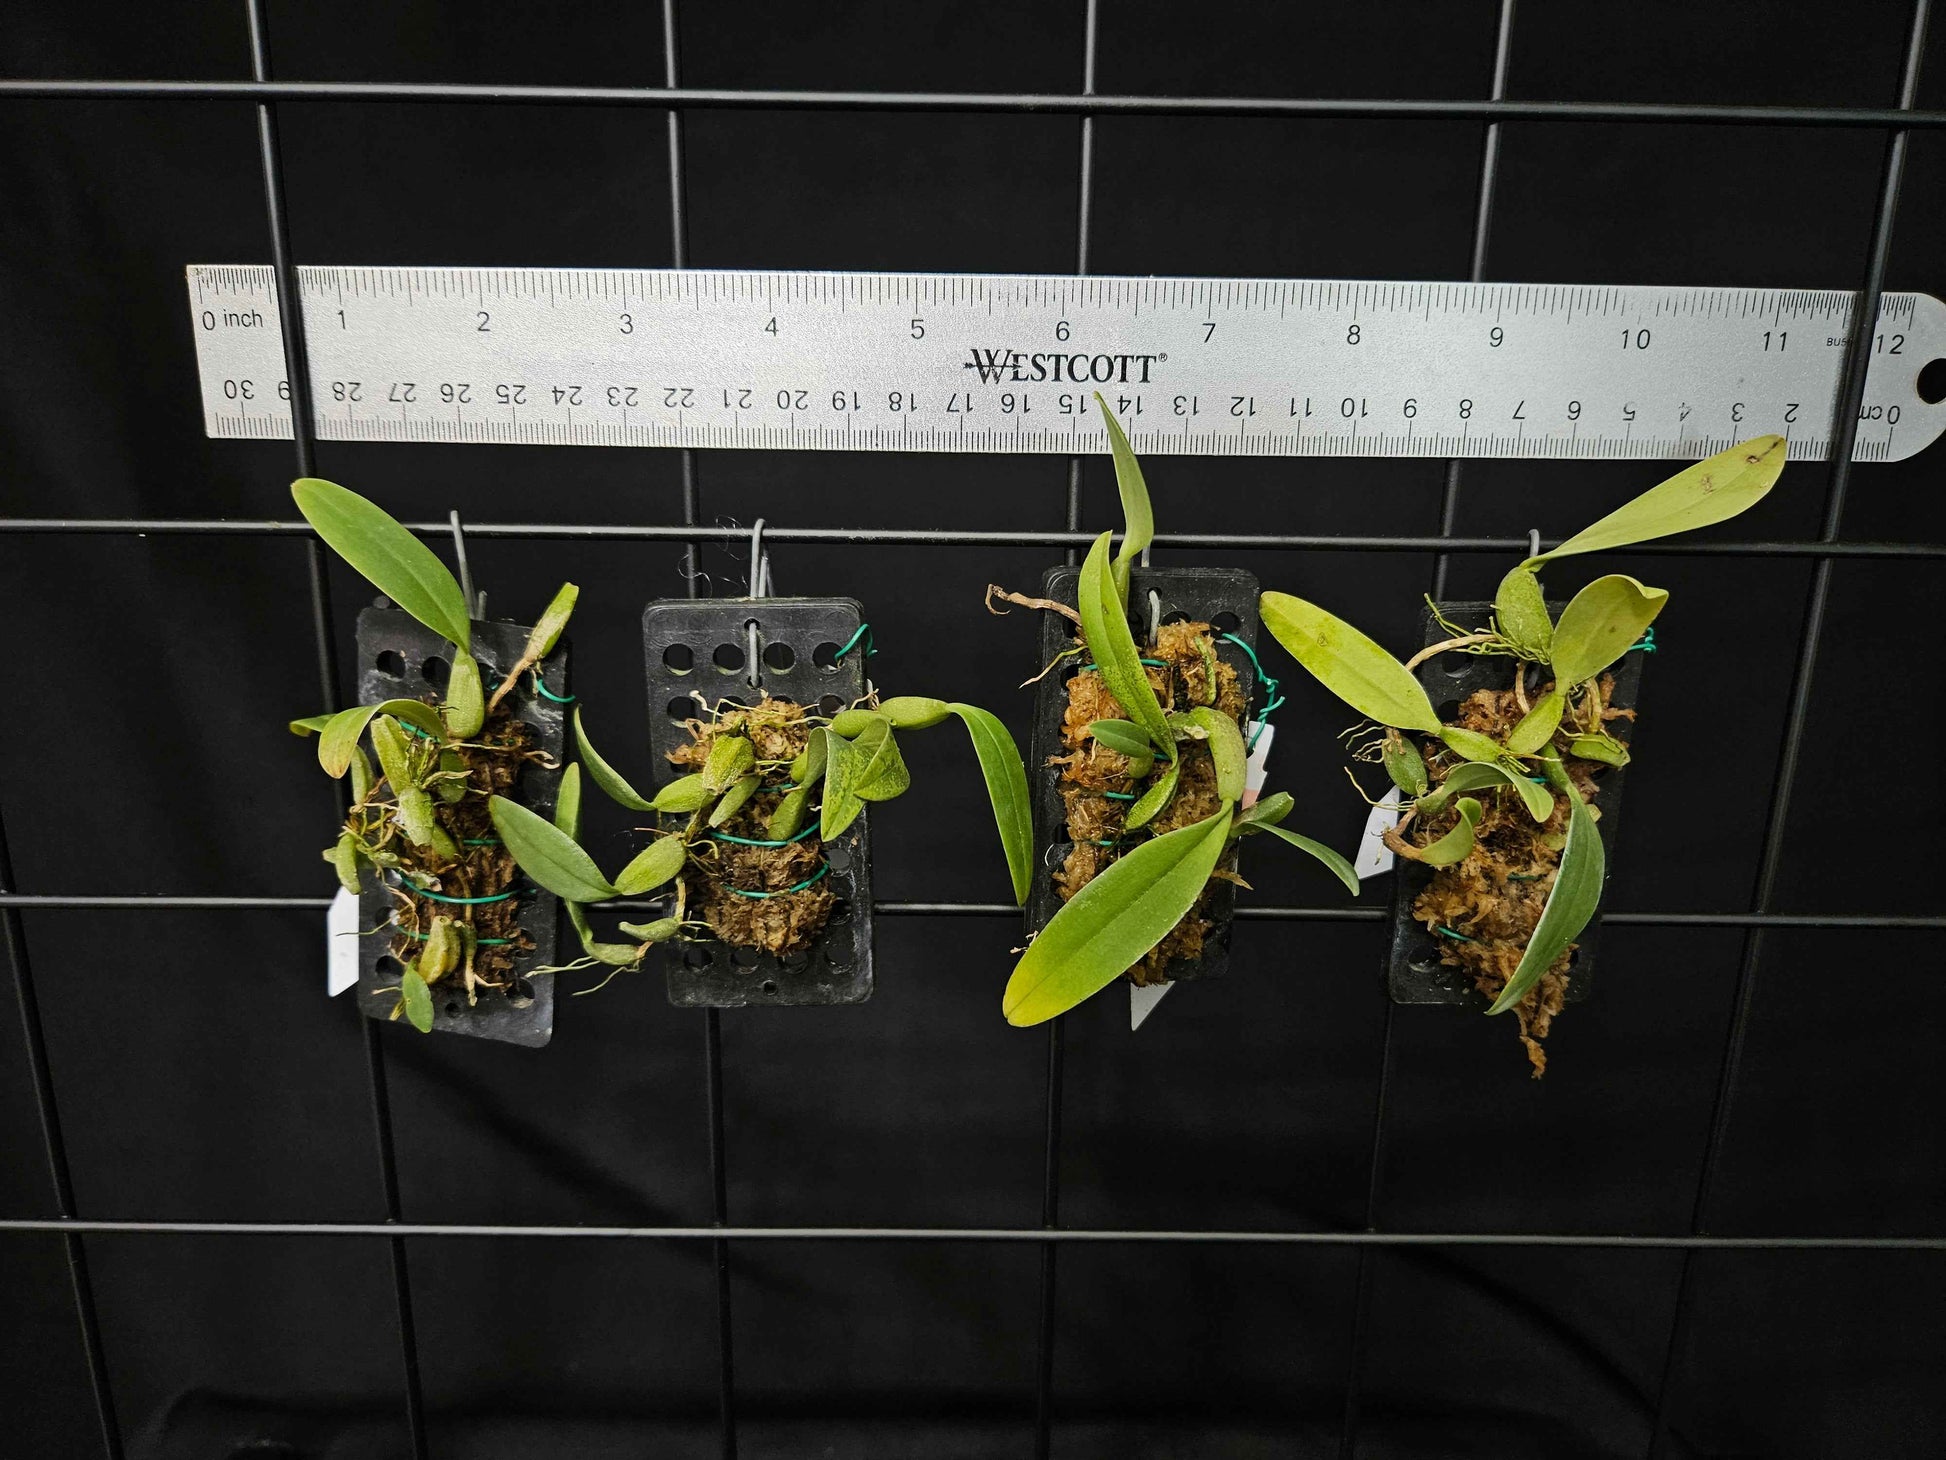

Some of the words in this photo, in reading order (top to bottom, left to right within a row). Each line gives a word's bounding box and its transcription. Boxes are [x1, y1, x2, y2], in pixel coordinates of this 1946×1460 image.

[202, 311, 215, 330] 0
[224, 309, 263, 328] inch
[338, 310, 346, 330] 1
[477, 311, 490, 331] 2
[620, 314, 633, 334] 3
[765, 317, 779, 337] 4
[911, 319, 924, 340] 5
[1056, 321, 1070, 341] 6
[1202, 323, 1216, 343] 7
[1347, 325, 1360, 345] 8
[1490, 327, 1503, 347] 9
[1622, 328, 1650, 350] 10
[1764, 331, 1787, 352] 11
[1877, 334, 1905, 354] 12
[224, 380, 254, 399] 30
[333, 382, 362, 401] 28
[389, 383, 416, 402] 27
[440, 383, 471, 403] 26
[496, 384, 526, 404] 25
[552, 386, 582, 405] 24
[607, 387, 638, 407] 23
[664, 388, 694, 408] 22
[723, 389, 753, 409] 21
[777, 390, 808, 410] 20
[832, 391, 861, 411] 19
[889, 392, 917, 412] 18
[946, 393, 973, 413] 17
[1001, 393, 1030, 414] 16
[1059, 394, 1087, 415] 15
[1117, 395, 1143, 415] 14
[1173, 396, 1199, 416] 13
[1230, 397, 1256, 416] 12
[1289, 398, 1312, 418] 11
[1341, 398, 1368, 418] 10
[1404, 398, 1417, 418] 9
[1459, 399, 1472, 419] 8
[1512, 400, 1525, 420] 7
[1567, 400, 1581, 421] 6
[1622, 402, 1636, 421] 5
[1678, 402, 1691, 421] 4
[1731, 402, 1745, 422] 3
[1784, 403, 1799, 423] 2
[1887, 405, 1900, 424] 0
